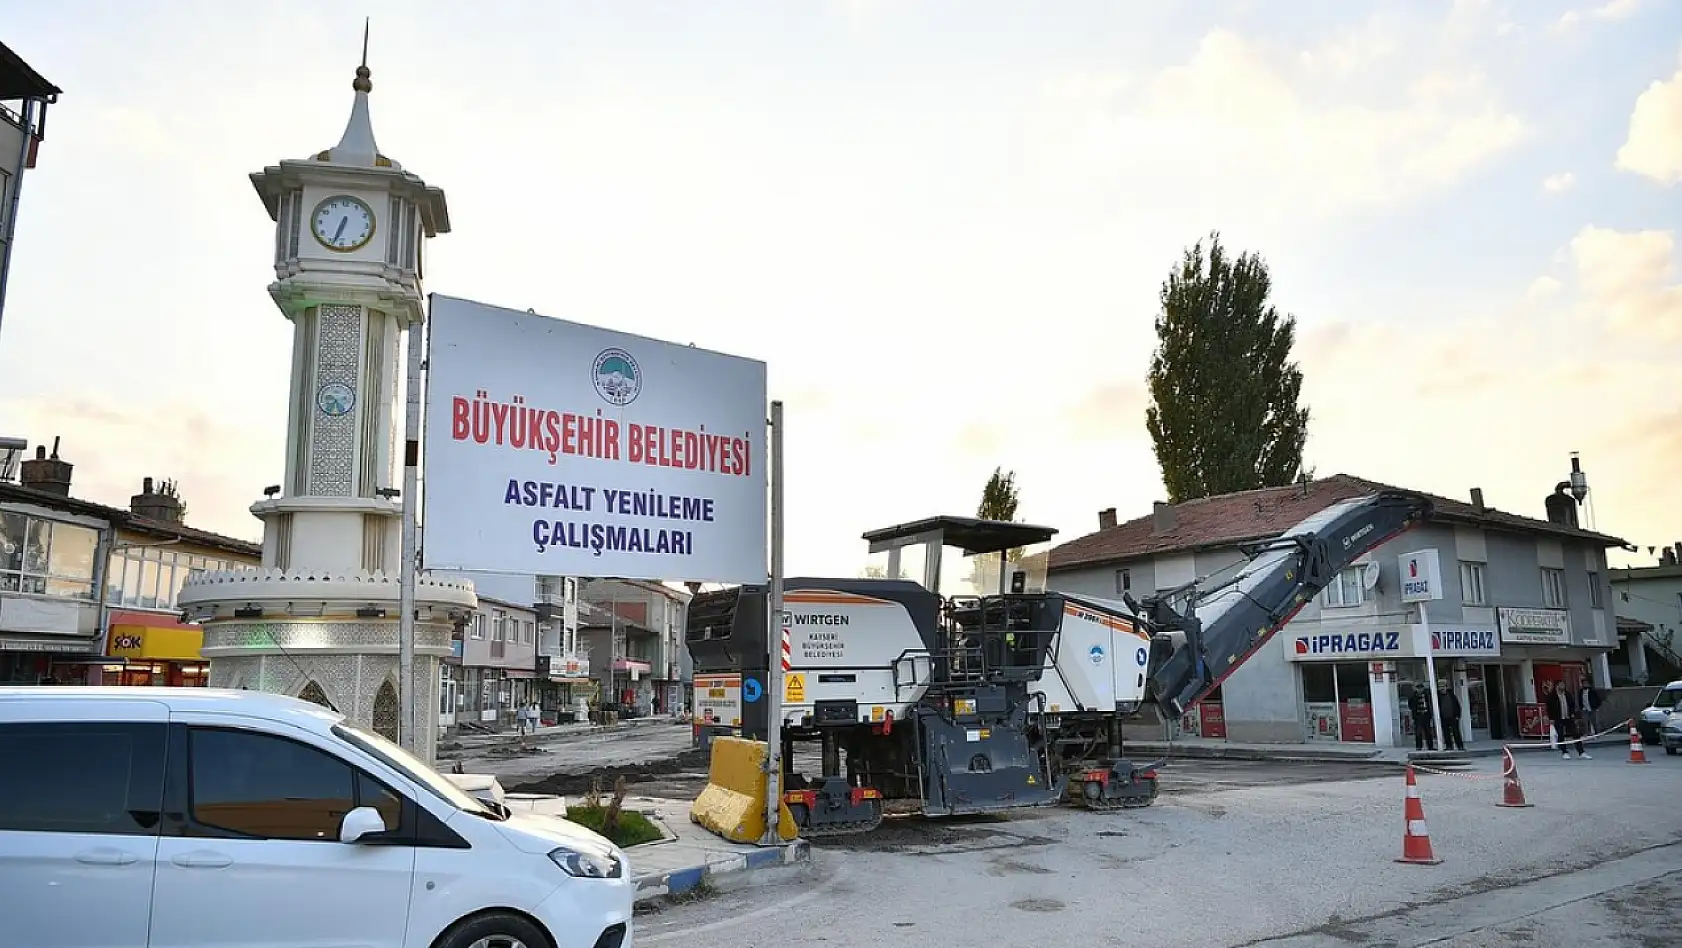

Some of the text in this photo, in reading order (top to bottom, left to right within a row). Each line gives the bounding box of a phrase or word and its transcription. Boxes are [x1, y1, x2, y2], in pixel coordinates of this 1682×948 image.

[452, 389, 751, 477] BÜYÜKŞEHİR BELEDİYESİ
[504, 479, 715, 522] ASFALT YENİLEME
[533, 519, 693, 557] ÇALIŞMALARI
[794, 614, 850, 625] WIRTGEN
